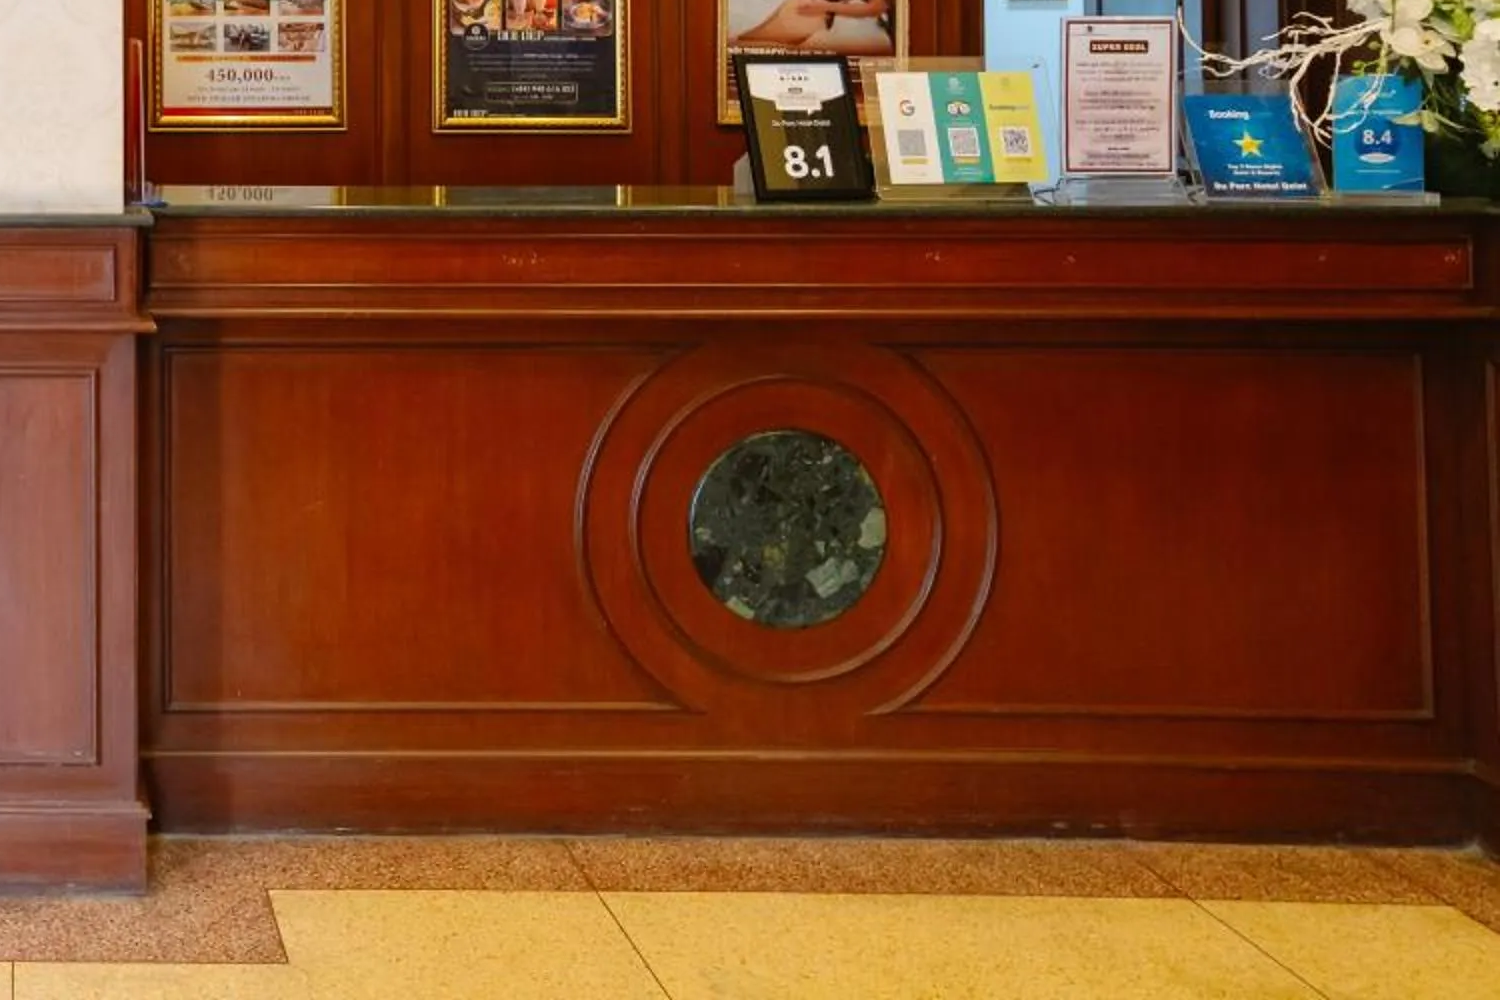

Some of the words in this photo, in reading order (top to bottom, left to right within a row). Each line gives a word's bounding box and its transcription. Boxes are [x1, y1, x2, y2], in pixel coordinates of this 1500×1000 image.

[899, 99, 915, 117] G
[1362, 129, 1393, 145] 8.4
[784, 145, 835, 179] 8.1
